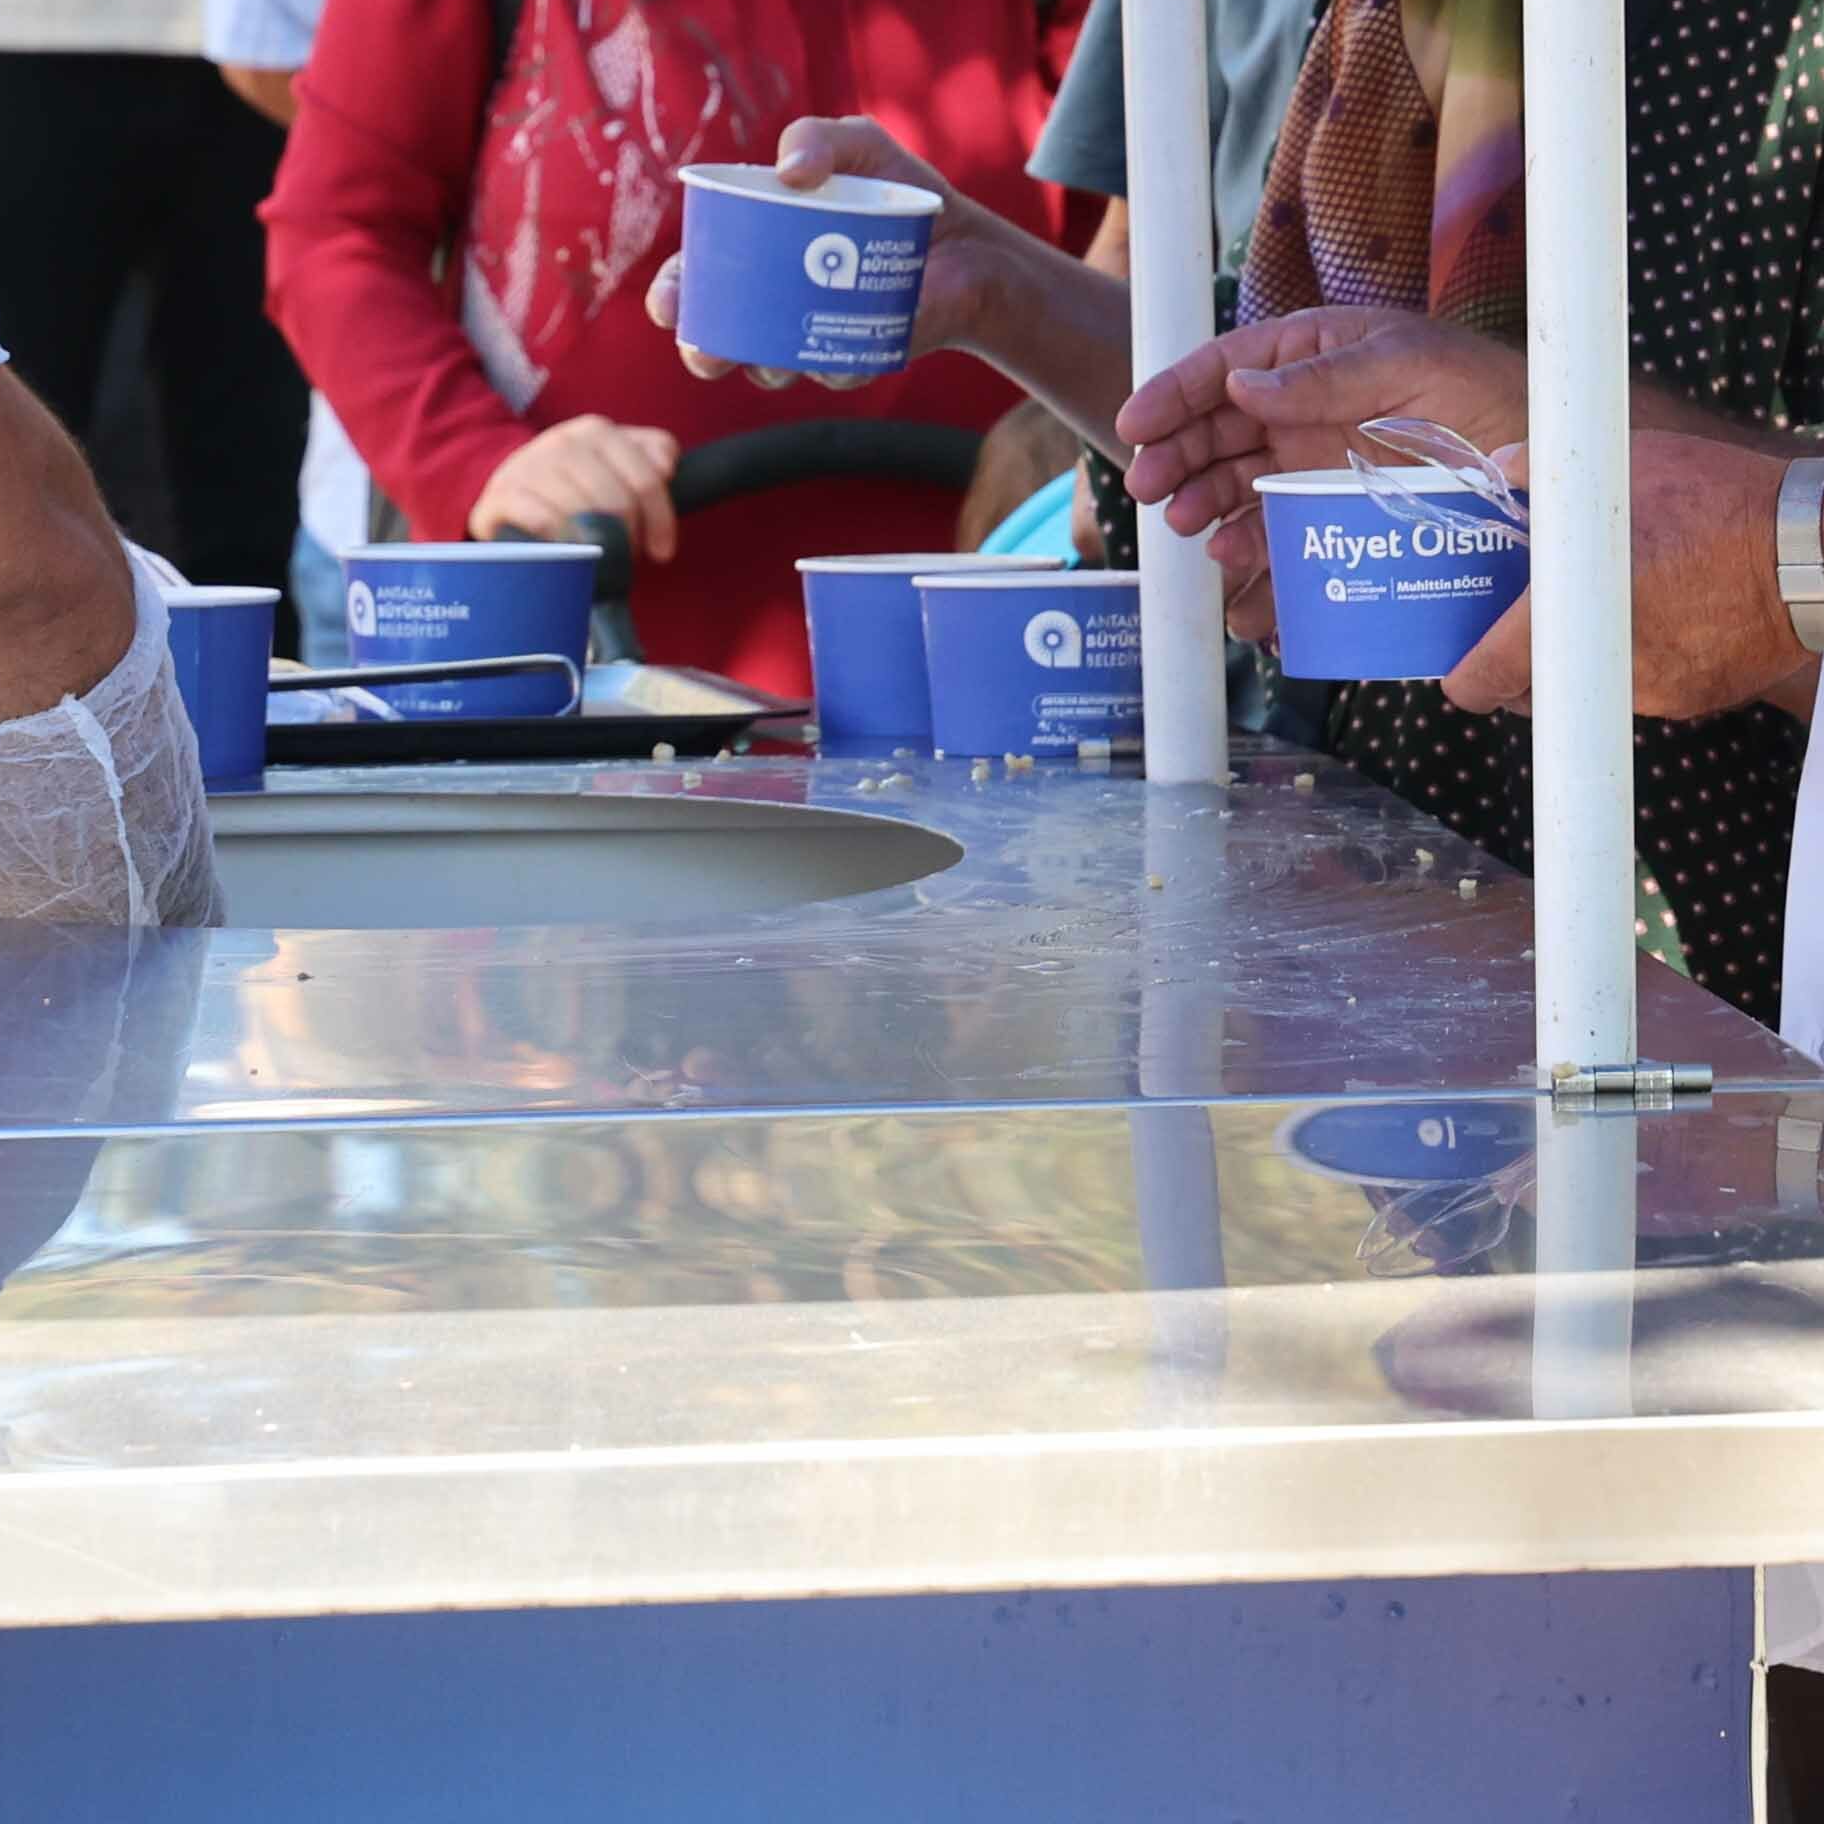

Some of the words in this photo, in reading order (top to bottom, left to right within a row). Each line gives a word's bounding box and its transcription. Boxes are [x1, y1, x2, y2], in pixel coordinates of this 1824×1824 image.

[1303, 525, 1404, 569] Afiyet
[1411, 523, 1514, 558] Olsun
[1397, 579, 1452, 593] Muhittin
[1453, 576, 1493, 590] BÖCEK
[1086, 630, 1141, 648] BÜYÜK
